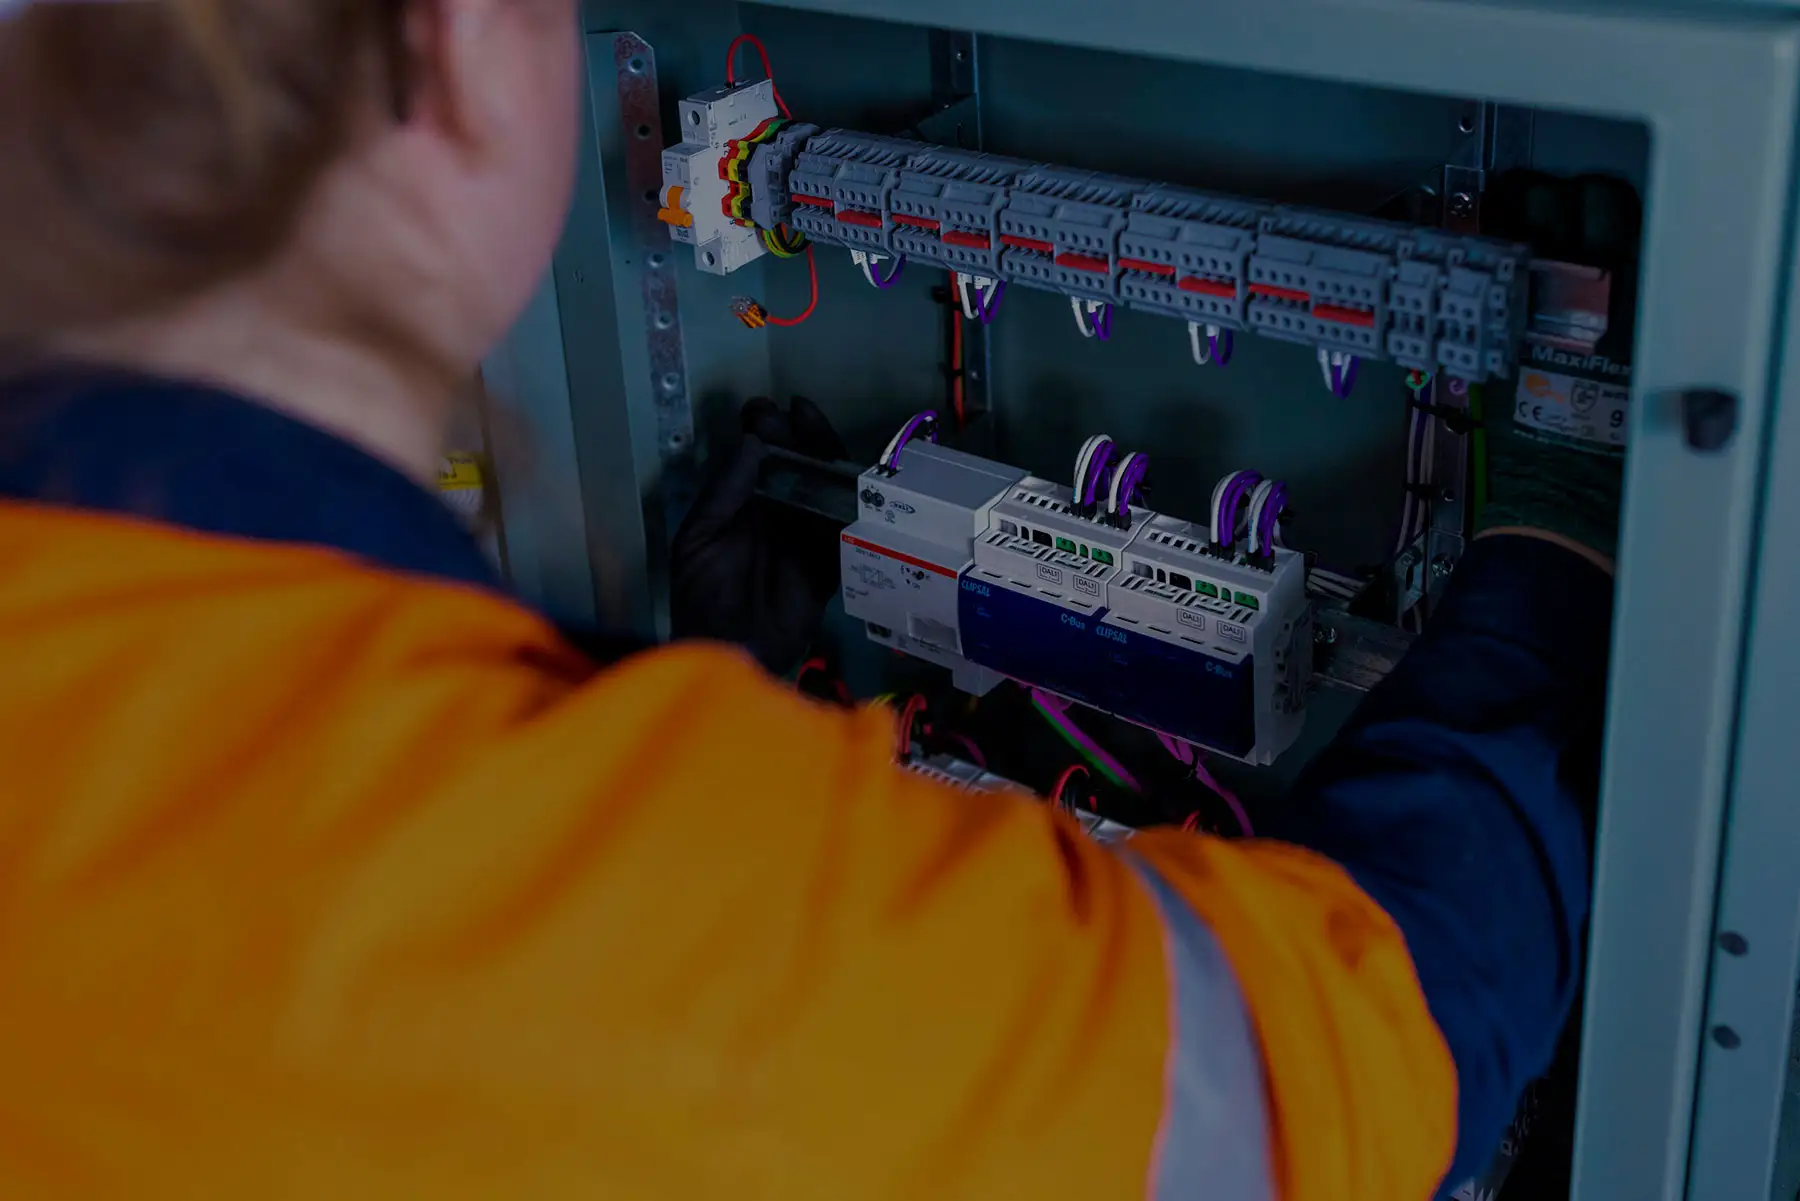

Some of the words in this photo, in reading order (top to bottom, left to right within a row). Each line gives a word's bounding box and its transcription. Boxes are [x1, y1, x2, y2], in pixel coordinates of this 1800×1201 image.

[1531, 344, 1633, 376] MaxiFlex
[1042, 566, 1057, 577] DALI
[961, 579, 991, 598] CLIPSAL
[1078, 578, 1094, 588] DALI
[1182, 612, 1199, 622] DALI
[1096, 624, 1128, 644] CLIPSAL
